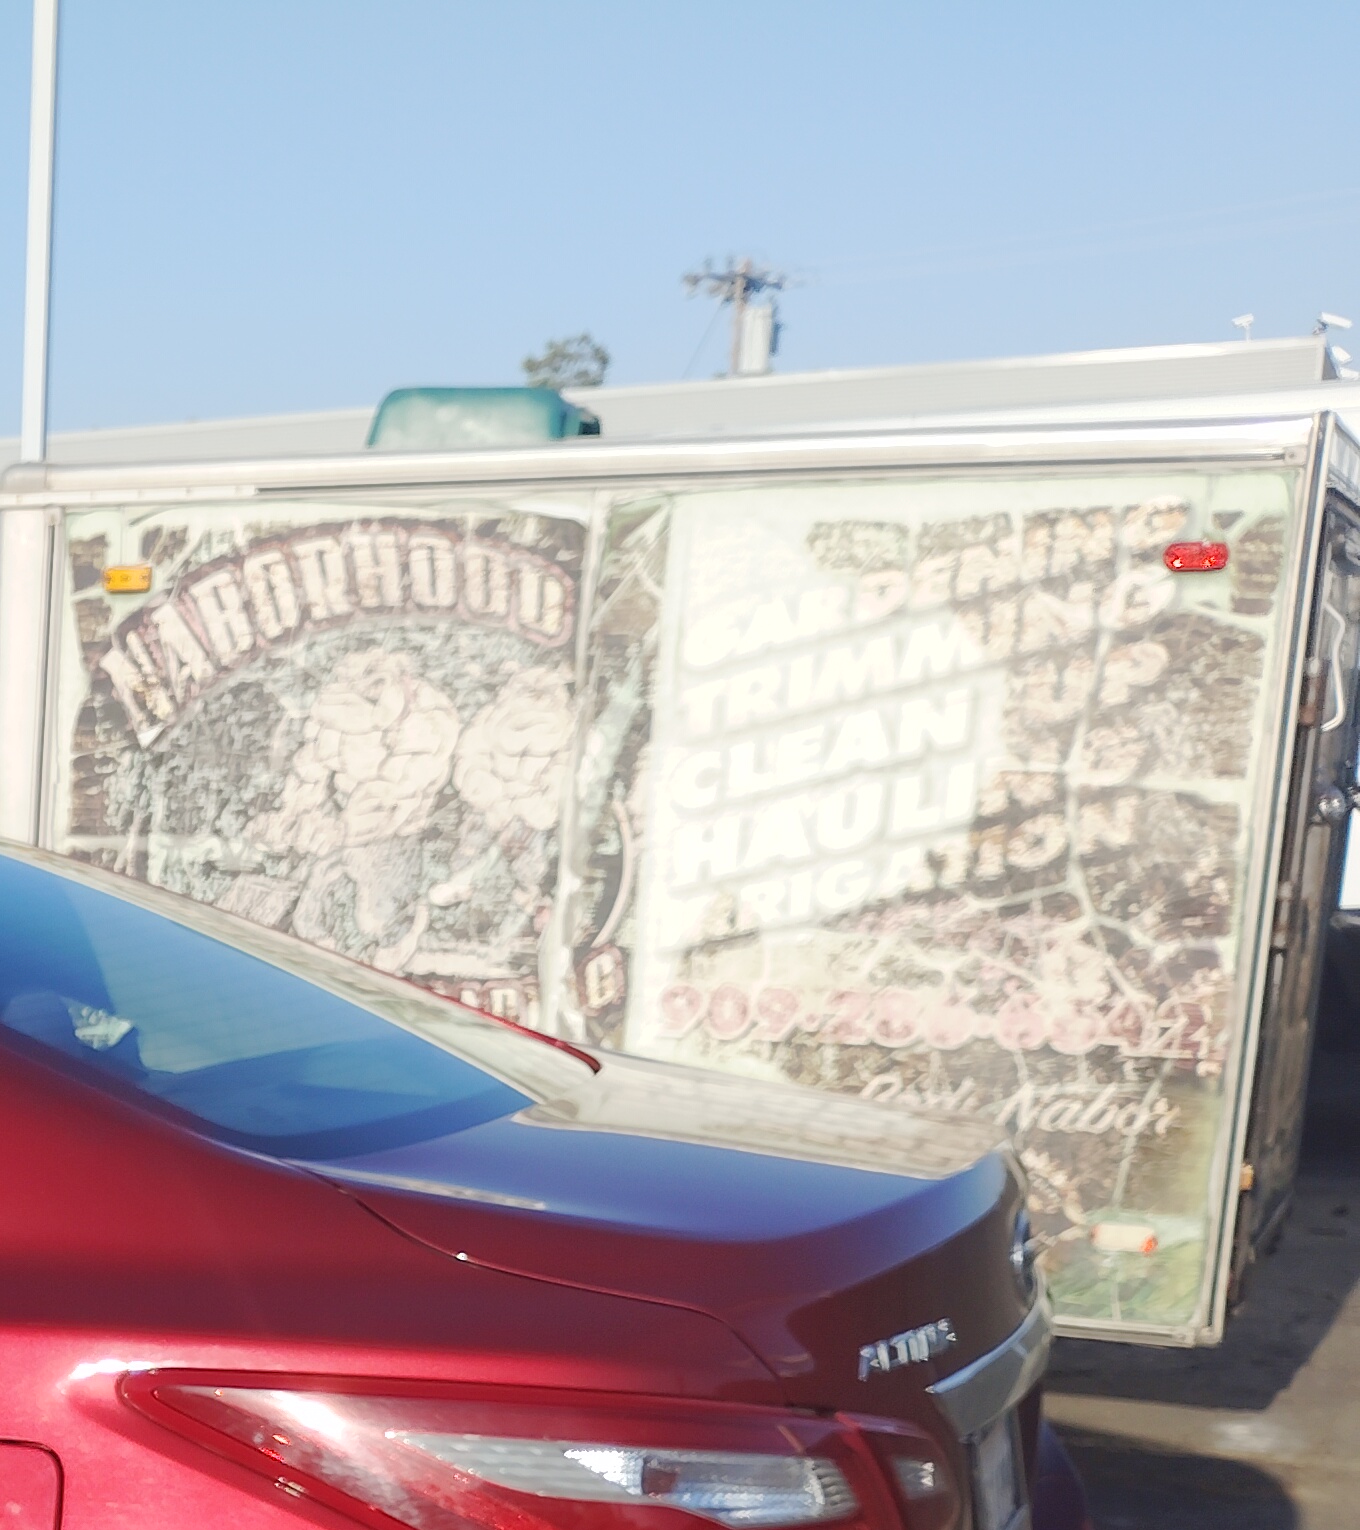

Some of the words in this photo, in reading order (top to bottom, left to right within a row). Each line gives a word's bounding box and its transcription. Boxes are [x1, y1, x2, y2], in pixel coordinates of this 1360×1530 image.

[98, 530, 568, 730] NABORHOOD
[682, 493, 1191, 669] GARDENING
[670, 688, 974, 810] CLEAN
